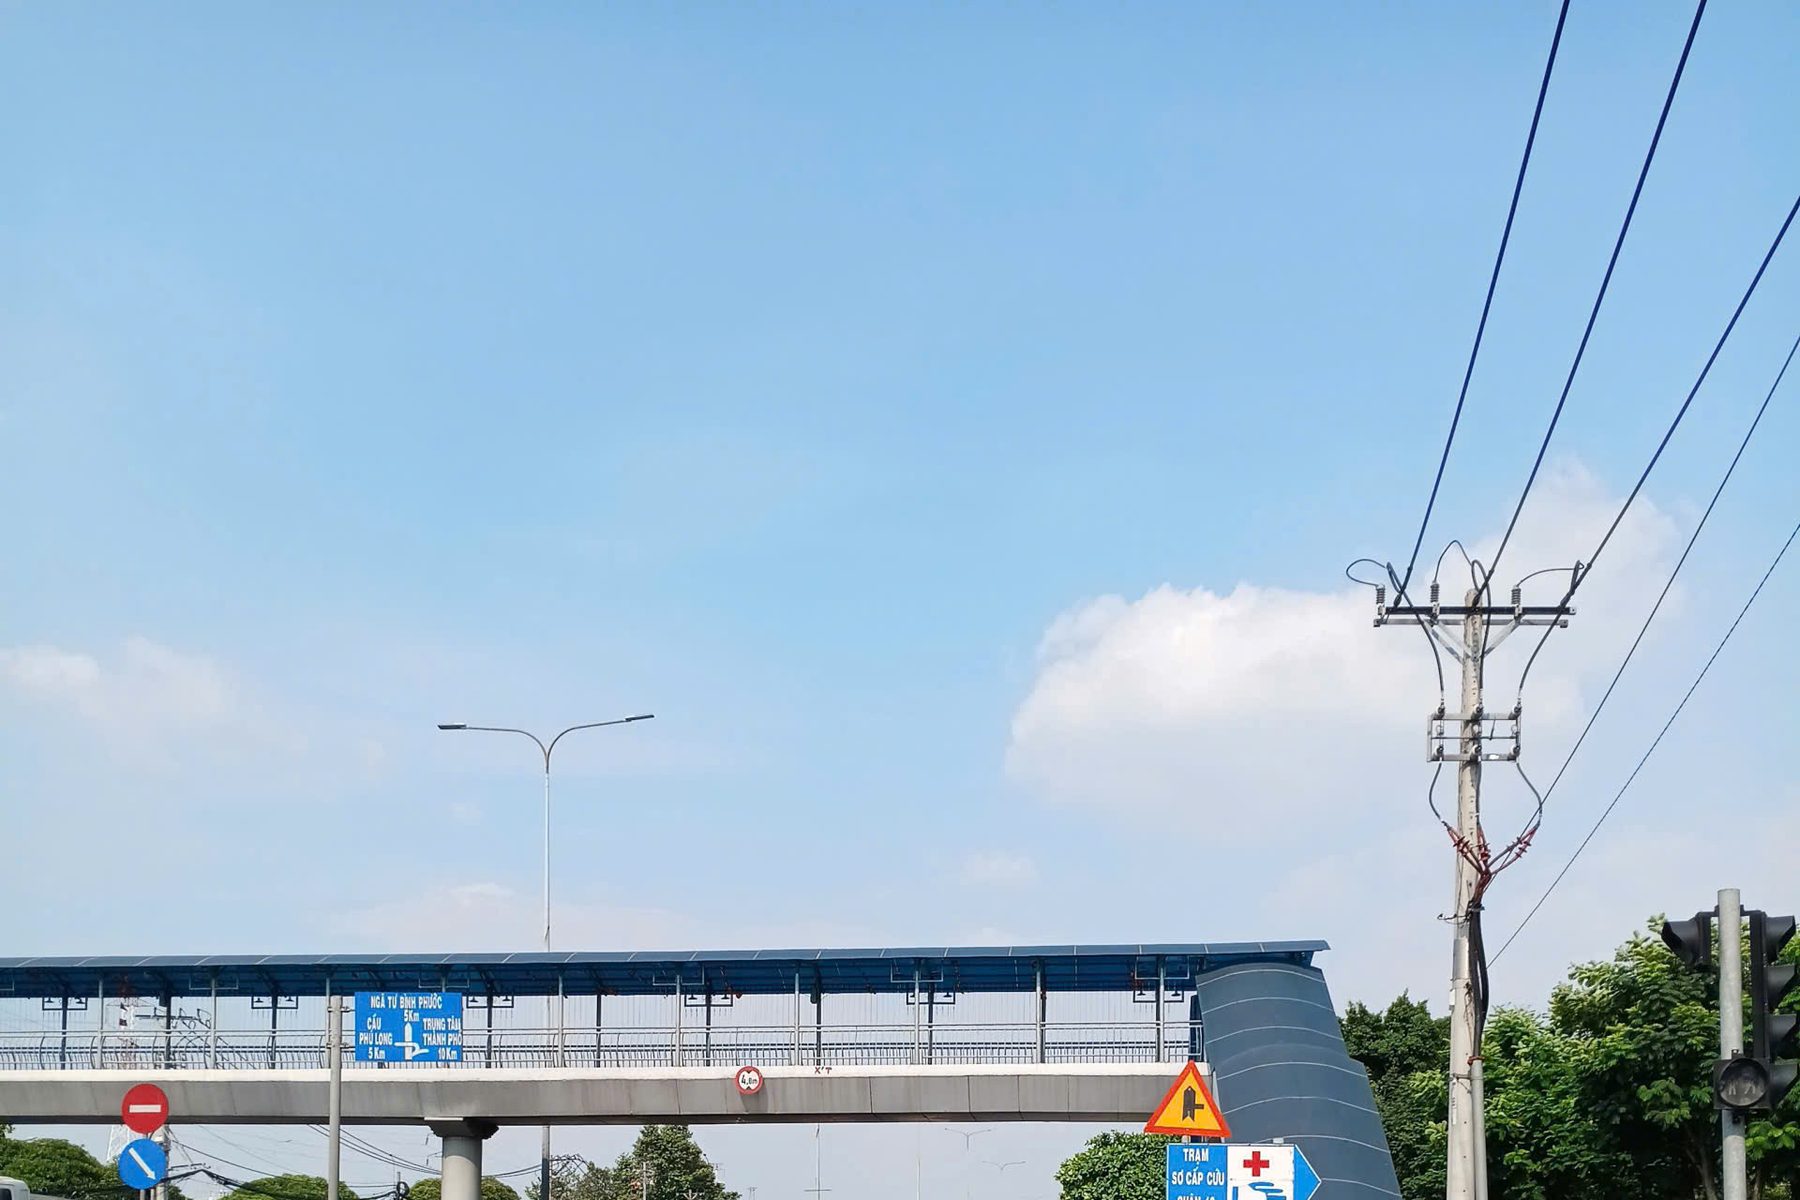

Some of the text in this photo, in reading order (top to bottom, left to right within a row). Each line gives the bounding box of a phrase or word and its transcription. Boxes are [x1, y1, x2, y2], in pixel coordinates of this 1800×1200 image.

[370, 993, 443, 1009] NGÃ TƯ BÌNH PHƯỚC
[422, 1017, 446, 1031] TRUNG
[374, 1032, 393, 1046] LONG
[1183, 1148, 1209, 1164] TRẠM
[1171, 1166, 1225, 1186] SƠ CẤP CỨU
